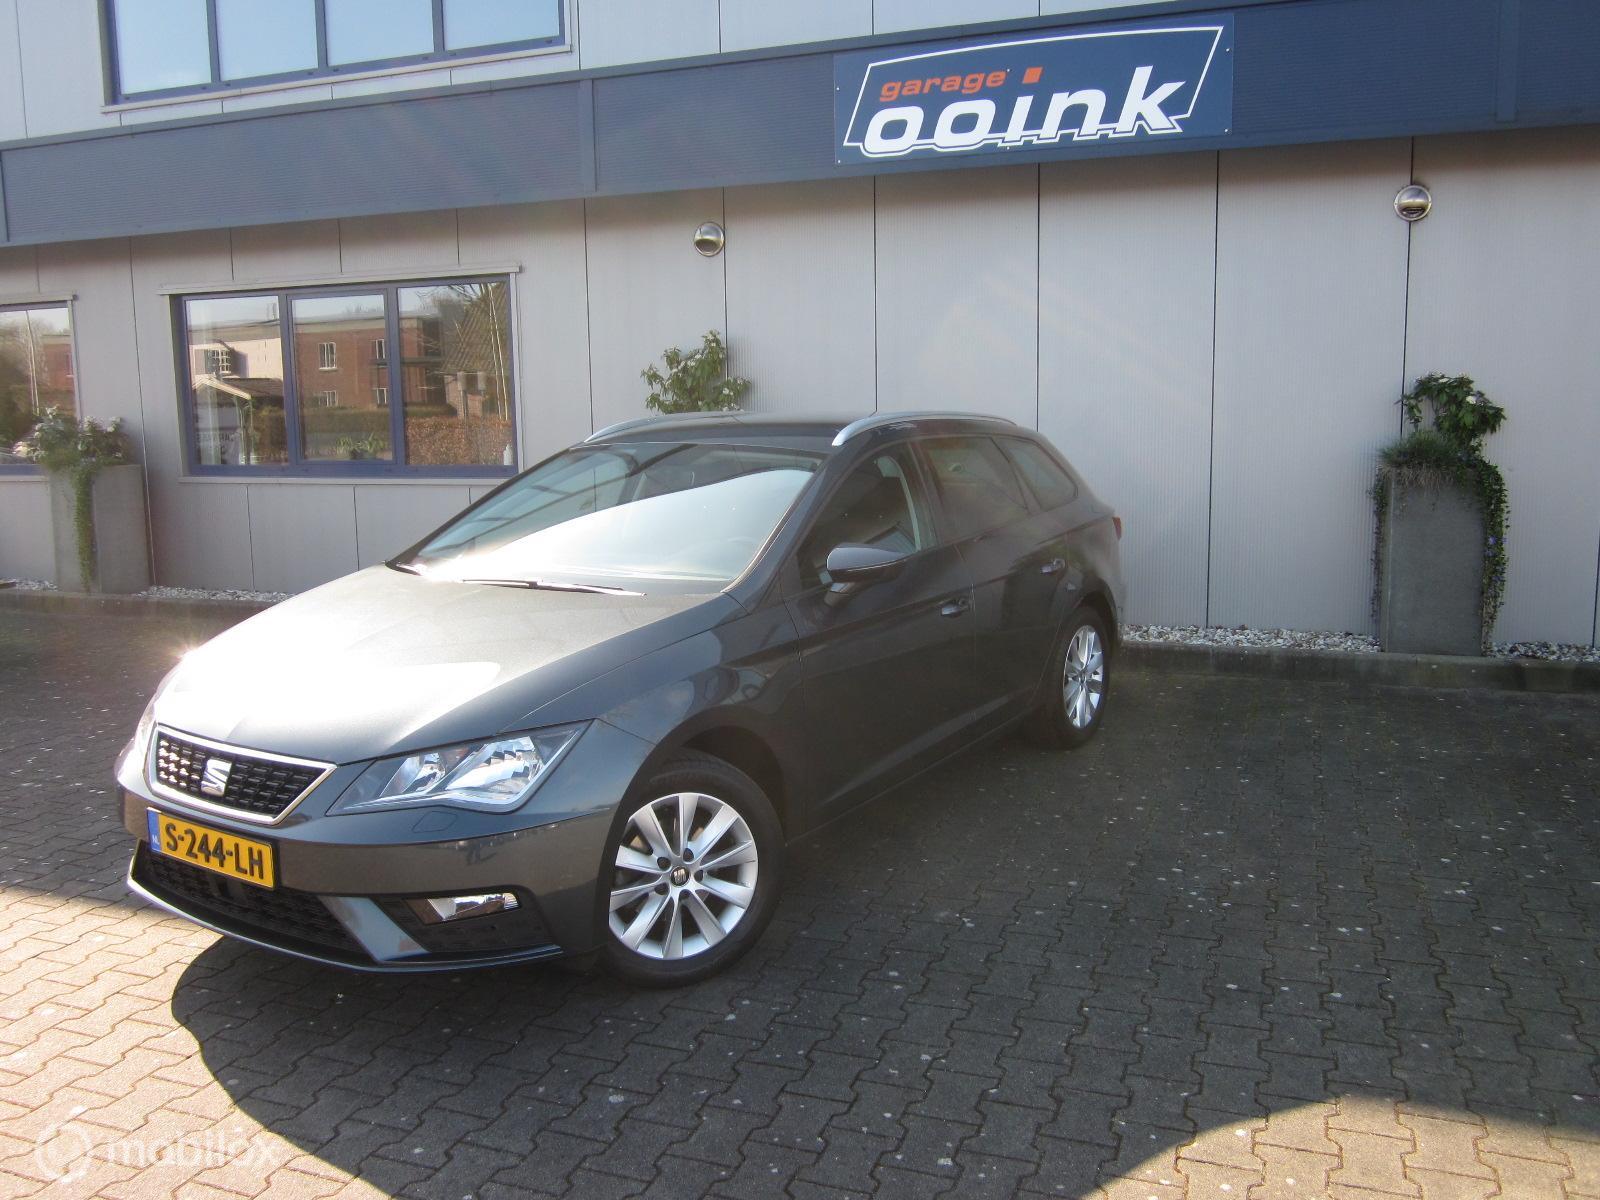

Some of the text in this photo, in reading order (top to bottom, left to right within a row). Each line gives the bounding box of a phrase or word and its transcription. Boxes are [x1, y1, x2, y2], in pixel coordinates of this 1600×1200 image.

[863, 65, 1187, 154] ooink
[879, 68, 1007, 102] garage
[164, 822, 265, 880] S-244-LH
